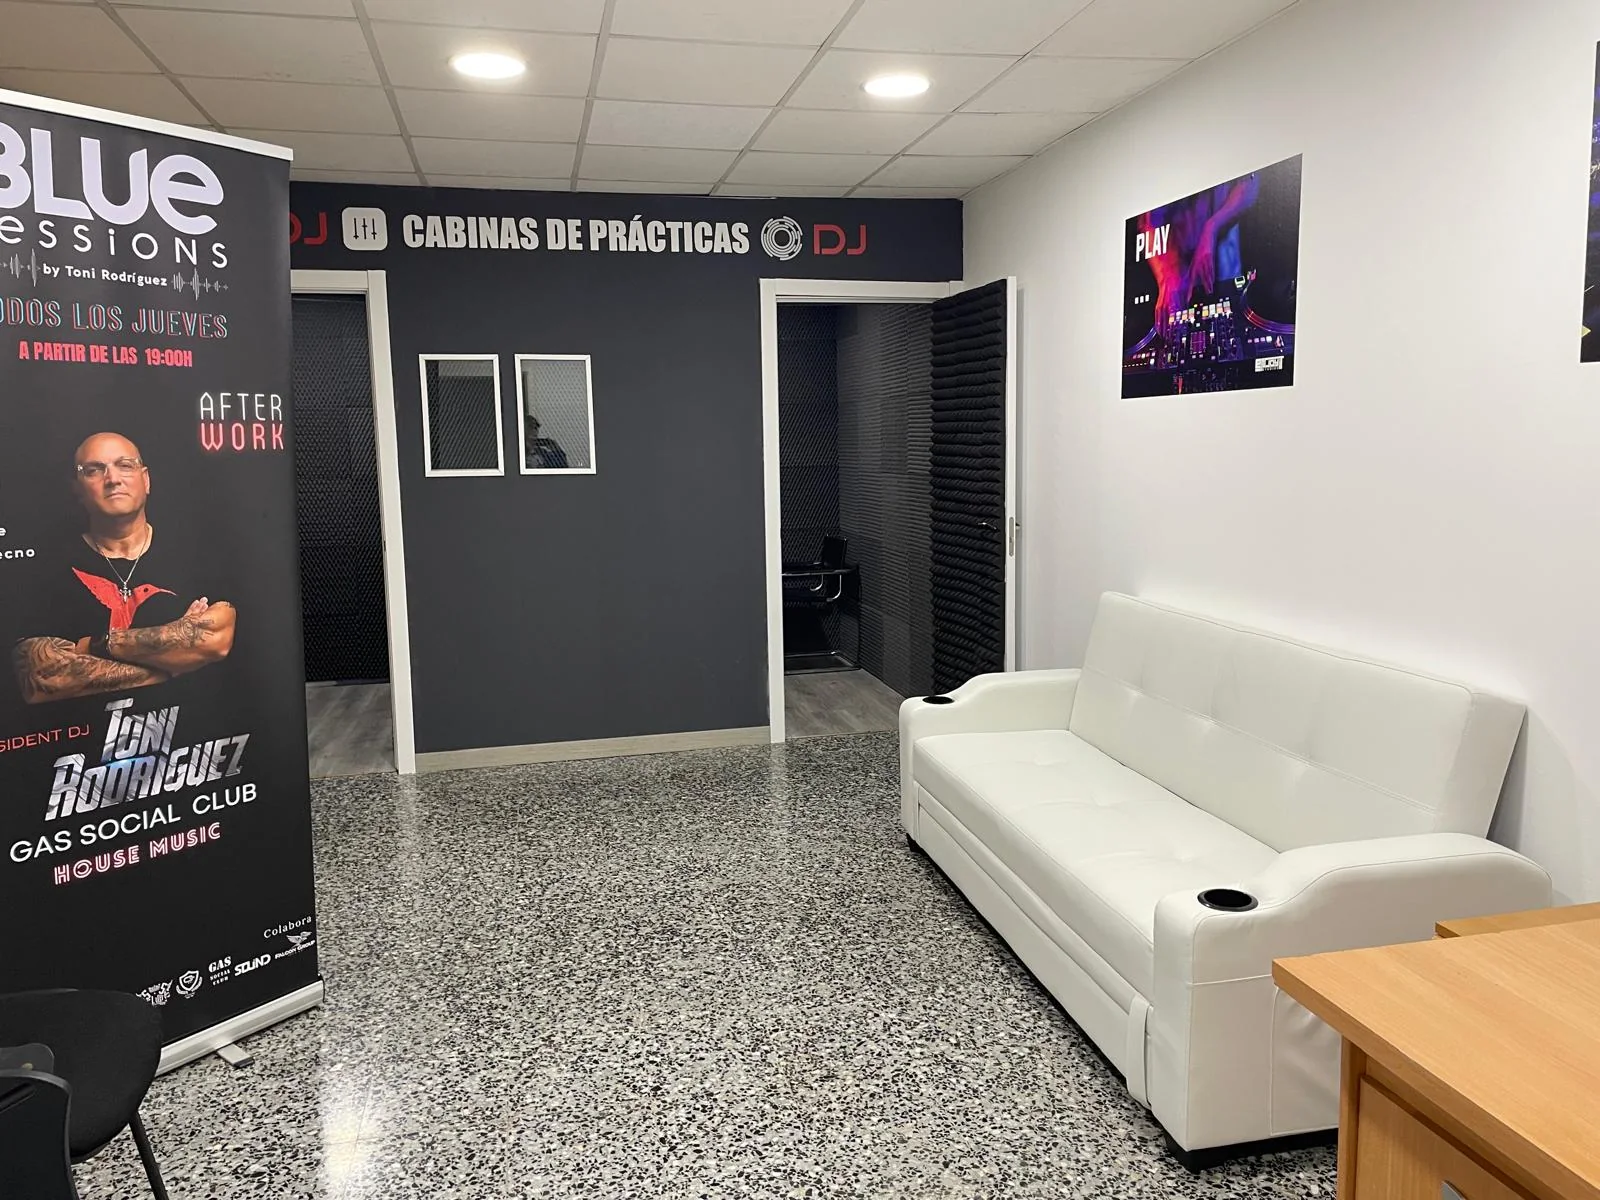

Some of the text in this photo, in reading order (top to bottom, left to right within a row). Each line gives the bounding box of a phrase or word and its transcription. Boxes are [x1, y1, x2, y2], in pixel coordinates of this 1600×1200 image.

[402, 214, 540, 250] CABINAS
[545, 218, 583, 251] DE
[588, 214, 750, 254] PRÁCTICAS
[813, 224, 867, 256] DJ
[1135, 223, 1171, 262] PLAY
[43, 263, 168, 286] by Toni Rodríguez
[0, 297, 228, 339] DOS LOS JUEVES
[19, 340, 193, 368] A PARTIR DE LAS 19:00H
[200, 391, 282, 421] AFTER
[201, 422, 284, 451] WORK
[0, 549, 35, 560] cno
[68, 723, 90, 739] DJ
[9, 783, 257, 863] GAS SOCIAL CLUB
[53, 822, 221, 885] HOUSE MUSIC
[263, 915, 312, 939] Colabora
[208, 955, 232, 973] GAS
